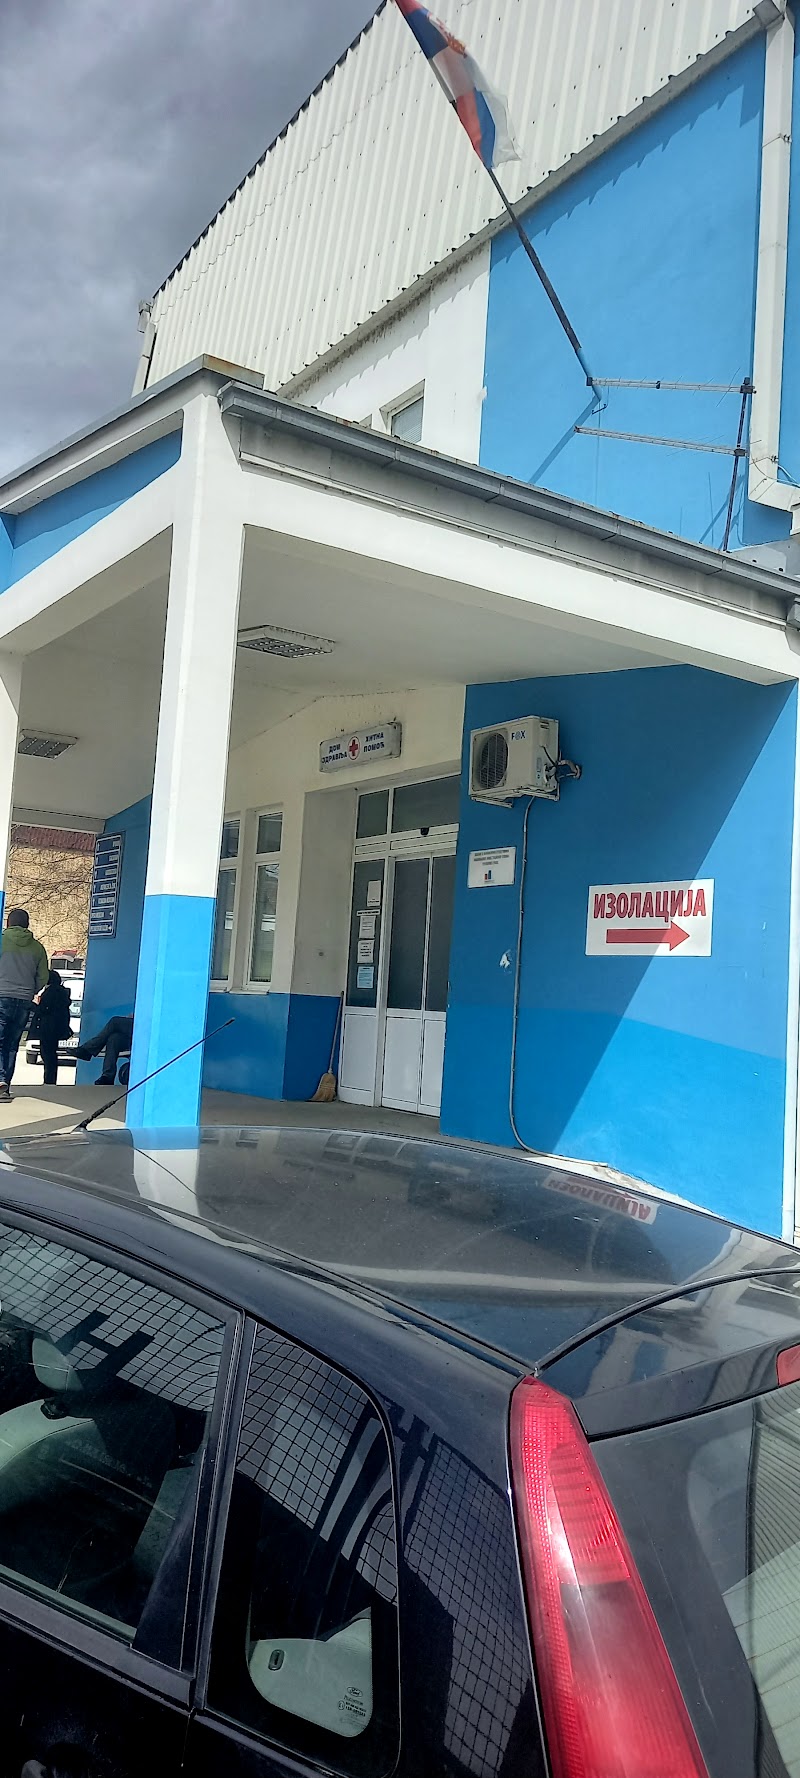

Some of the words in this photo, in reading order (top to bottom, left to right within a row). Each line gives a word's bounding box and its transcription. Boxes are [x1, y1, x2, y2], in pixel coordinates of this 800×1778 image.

[365, 731, 384, 743] ХИТНА
[511, 730, 526, 740] FOX
[329, 743, 341, 754] ДОМ
[363, 741, 385, 752] ПОМОЋ
[321, 751, 348, 764] ЗДРАВЉА
[593, 889, 707, 923] ИЗОЛАЦИЈА
